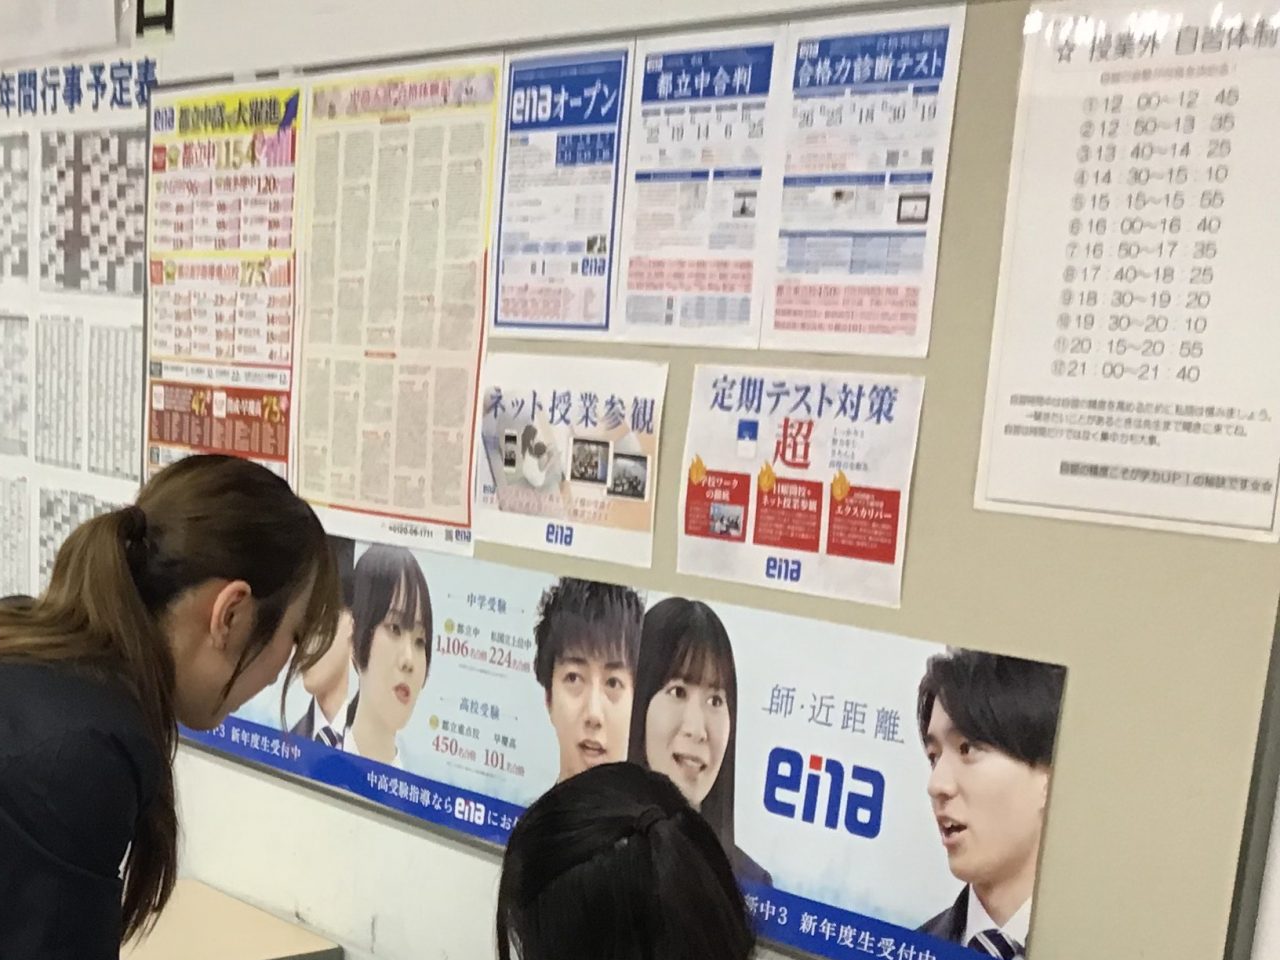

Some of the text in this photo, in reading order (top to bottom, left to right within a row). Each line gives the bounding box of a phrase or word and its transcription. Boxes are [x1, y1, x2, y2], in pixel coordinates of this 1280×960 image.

[488, 386, 655, 434] ネット授業参観
[710, 374, 898, 425] 定期テスト対策
[772, 416, 815, 470] 超
[545, 522, 574, 546] ena
[765, 556, 802, 582] ena
[467, 592, 507, 615] 中学受験
[459, 697, 500, 720] 高校受験
[762, 683, 905, 744] 師・近距離
[763, 746, 886, 839] ena
